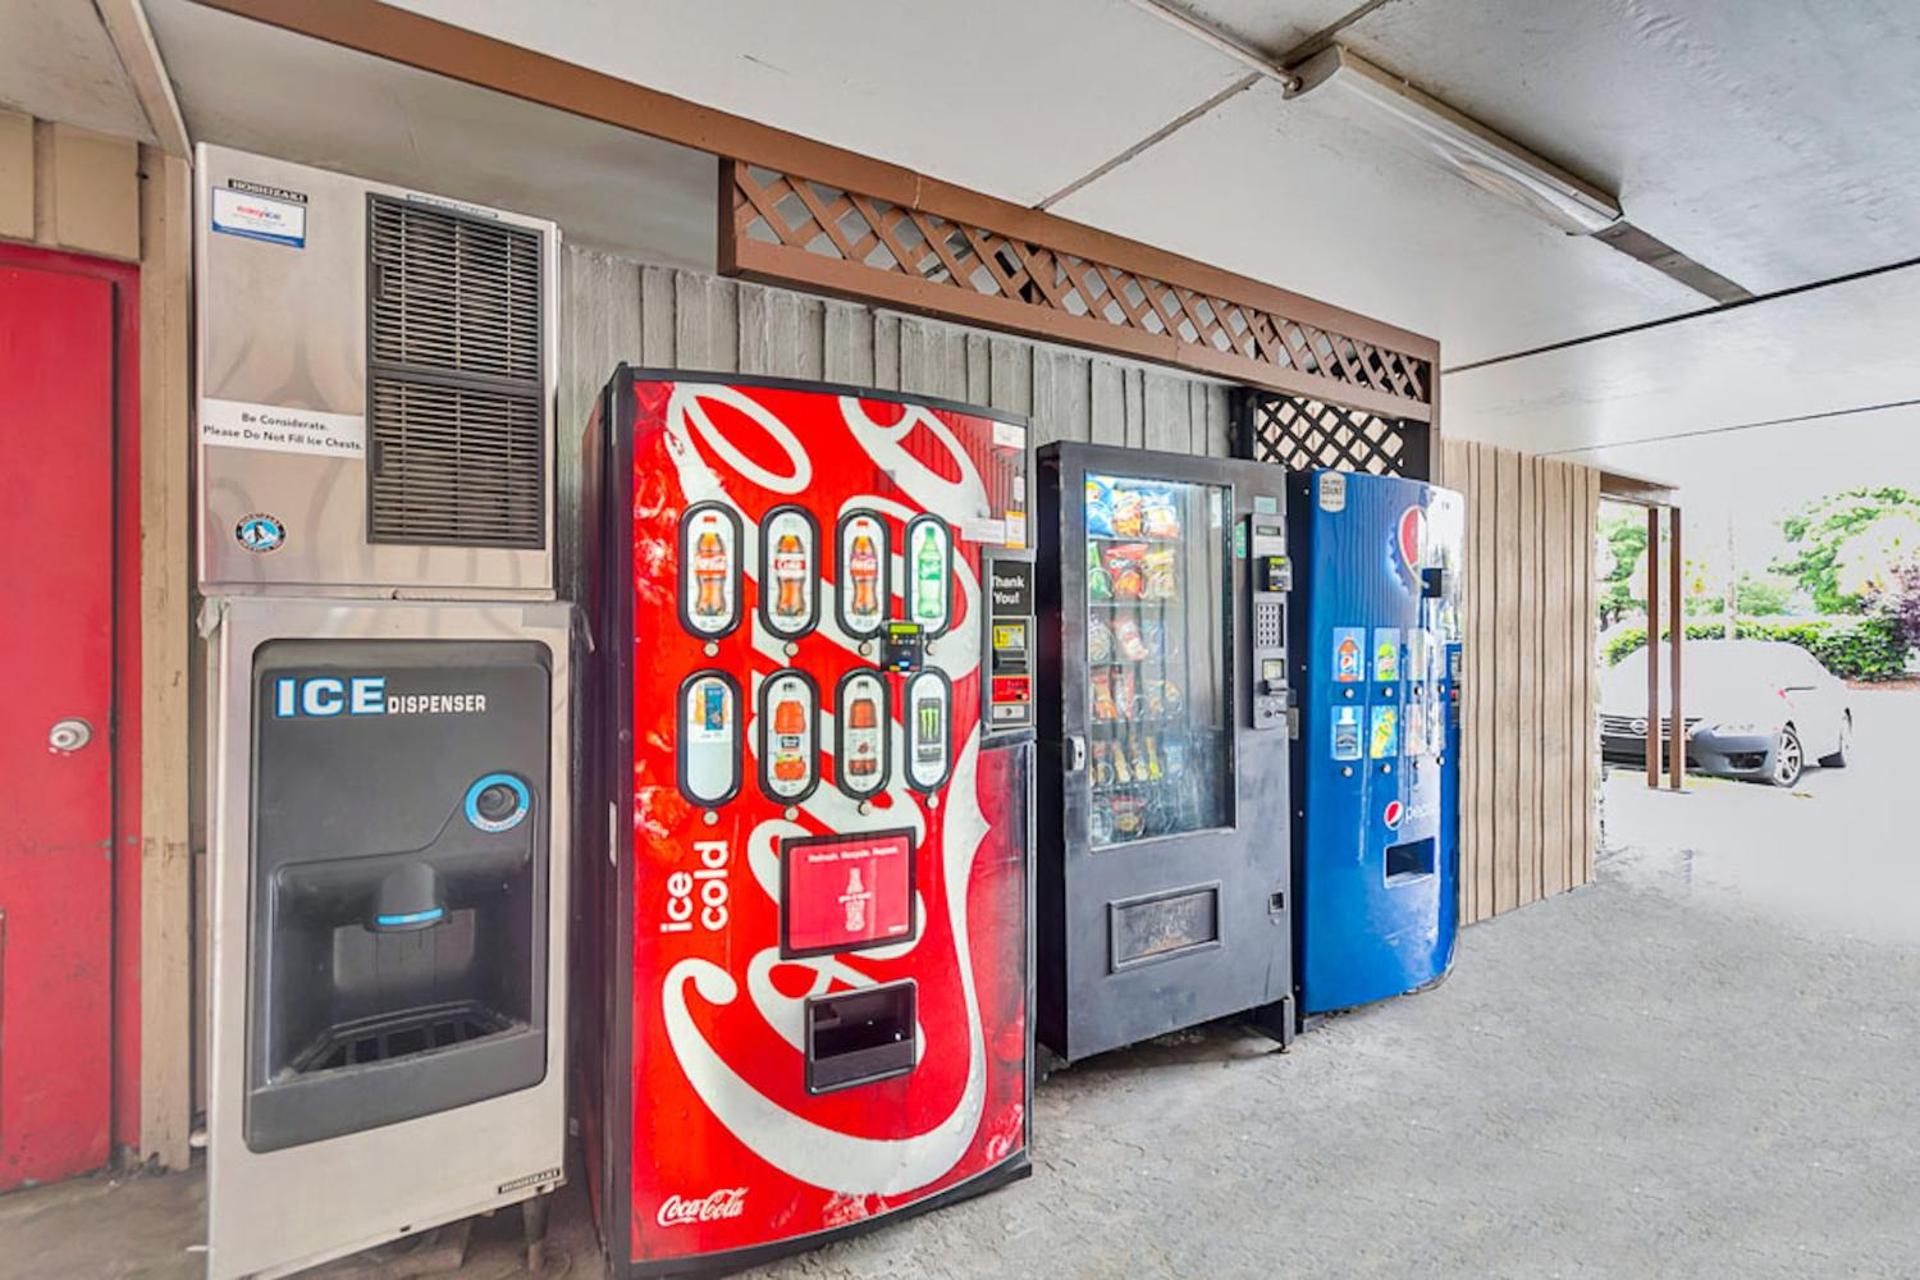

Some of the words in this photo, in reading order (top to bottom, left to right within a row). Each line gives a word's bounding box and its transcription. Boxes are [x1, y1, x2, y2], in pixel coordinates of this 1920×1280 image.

[203, 424, 240, 438] Please
[243, 429, 260, 440] Do
[263, 431, 285, 442] Not
[288, 433, 304, 444] Fill
[307, 435, 321, 446] Ice
[325, 437, 363, 450] Chests.
[241, 412, 256, 423] Be
[259, 414, 328, 431] Considerate.
[994, 591, 1020, 605] You!
[275, 676, 386, 717] ICE
[388, 694, 486, 715] DISPENSER
[660, 872, 693, 933] ice
[693, 840, 729, 931] cold
[657, 1187, 749, 1227] Coca-Cola
